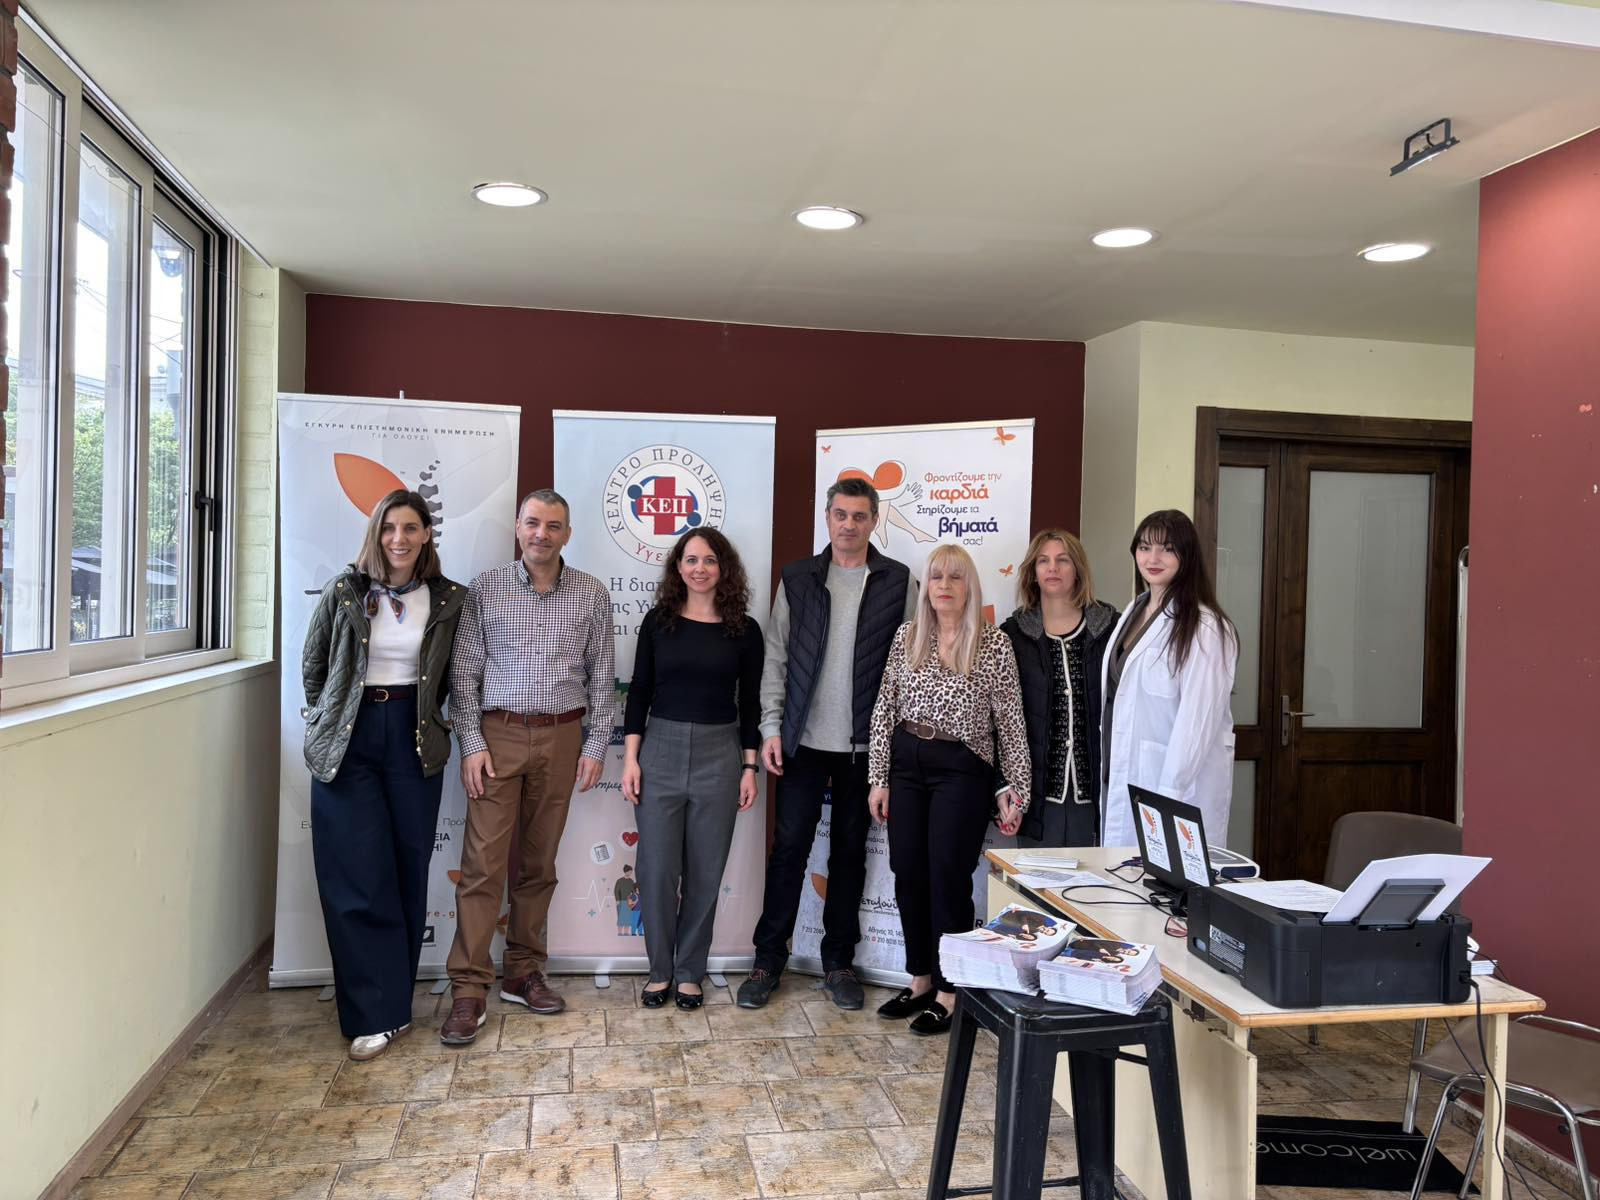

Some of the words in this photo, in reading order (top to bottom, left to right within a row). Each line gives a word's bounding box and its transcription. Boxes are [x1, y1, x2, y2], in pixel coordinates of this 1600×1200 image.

[350, 424, 428, 433] ΕΠΙΣΤΗΜΟΝΙΚΗ
[434, 428, 495, 437] ΕΝΗΜΕΡΩΣΗ
[924, 471, 986, 483] Φροντίζουμε
[987, 473, 1002, 482] την
[606, 456, 642, 534] ΚΕΝΤΡΟ
[930, 483, 989, 504] καρδιά
[642, 498, 688, 514] ΚΕΠ
[917, 504, 968, 516] Στηρίζουμε
[938, 516, 999, 537] βήματά
[963, 536, 983, 546] σας!
[610, 577, 623, 591] Η
